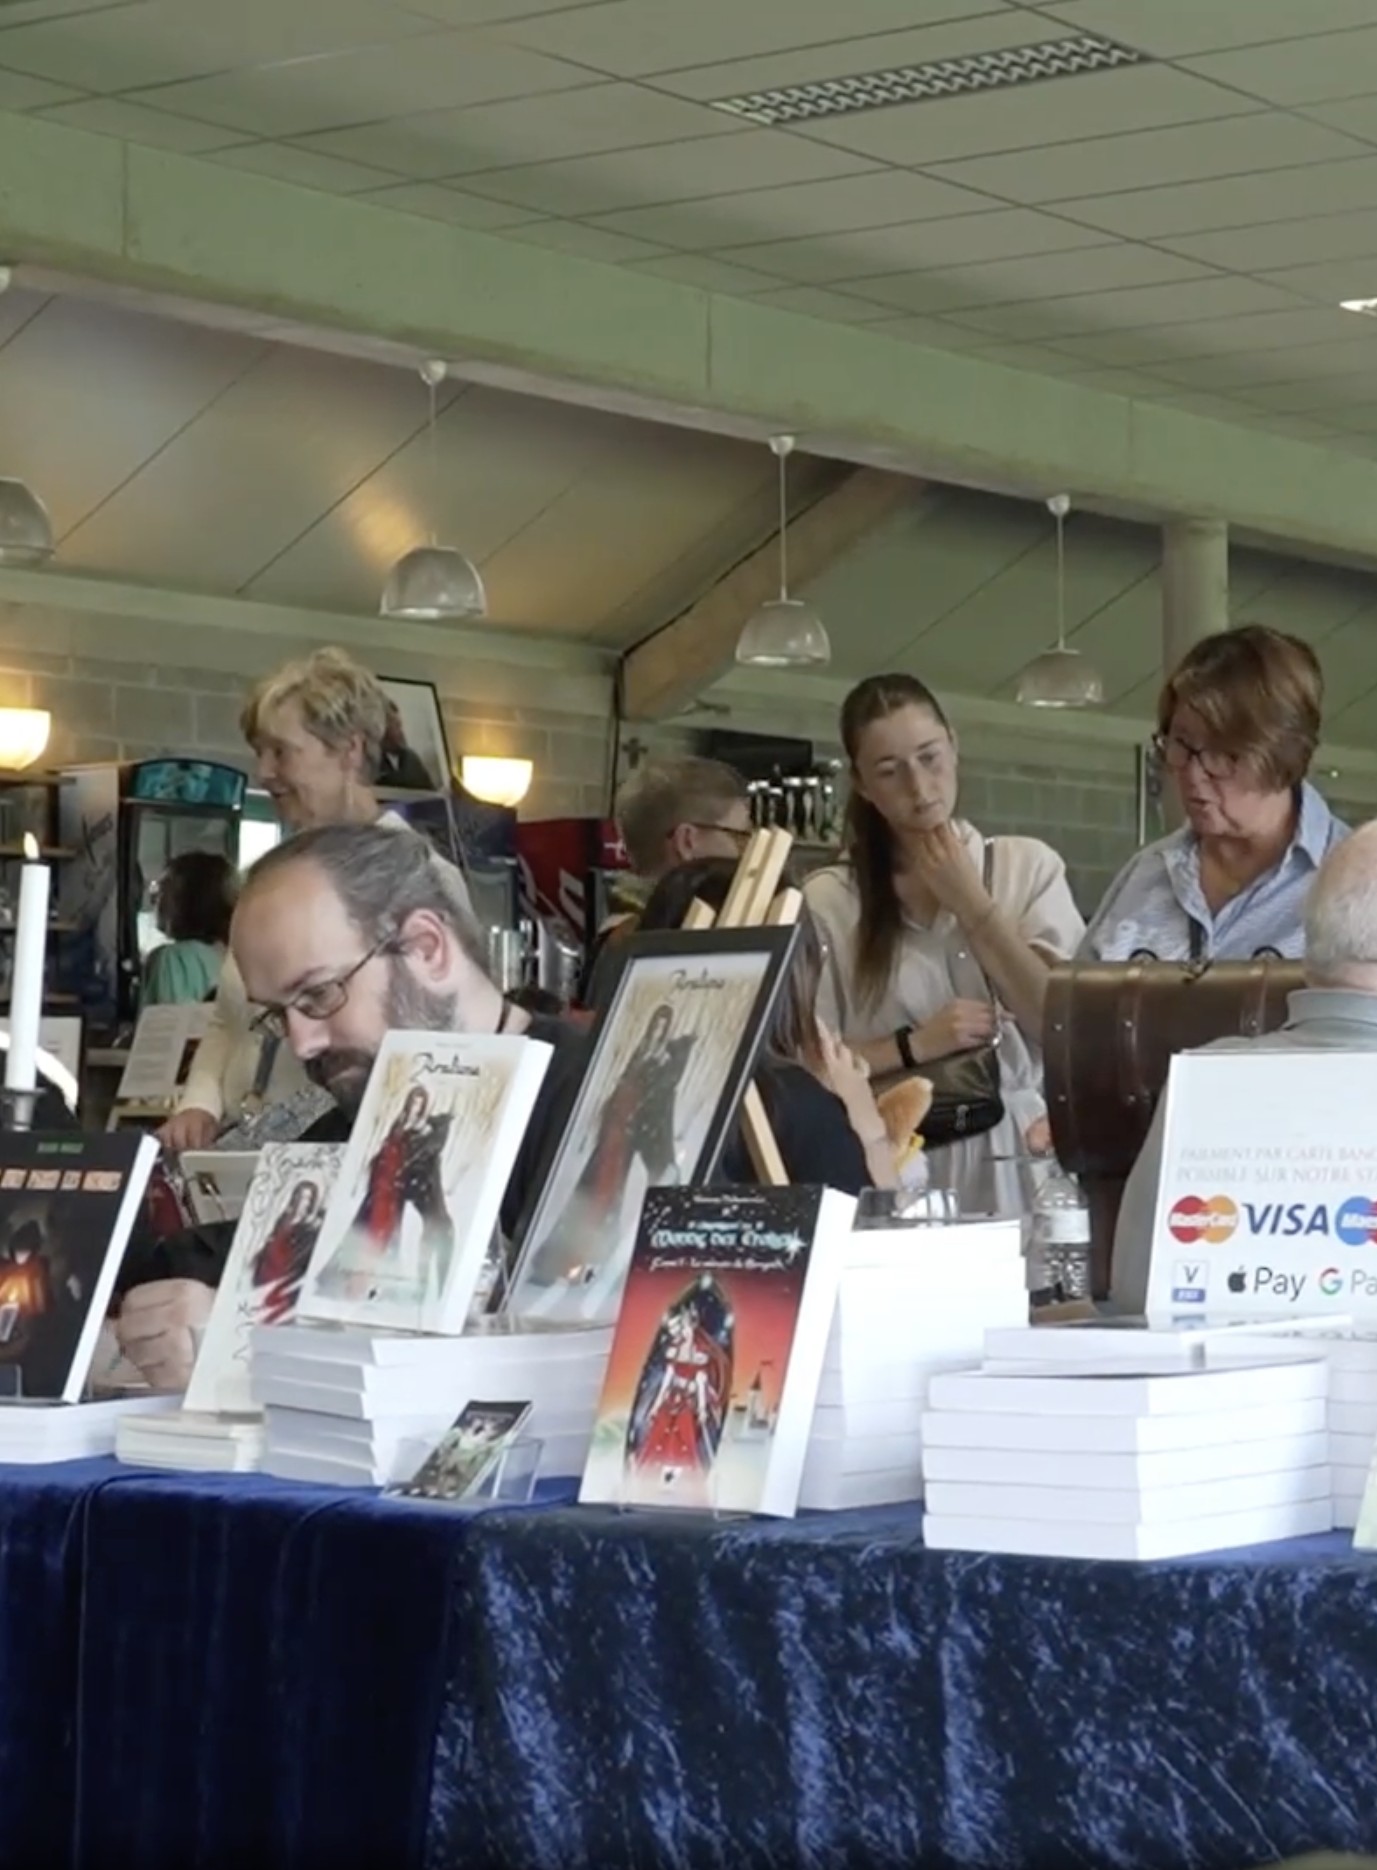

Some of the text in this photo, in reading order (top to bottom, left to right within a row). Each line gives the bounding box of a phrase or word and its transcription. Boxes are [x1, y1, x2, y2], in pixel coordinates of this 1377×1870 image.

[1287, 1147, 1334, 1161] CARTE
[1293, 1168, 1350, 1184] NOTRE
[1242, 1203, 1329, 1236] VISA
[1253, 1266, 1306, 1301] Pay
